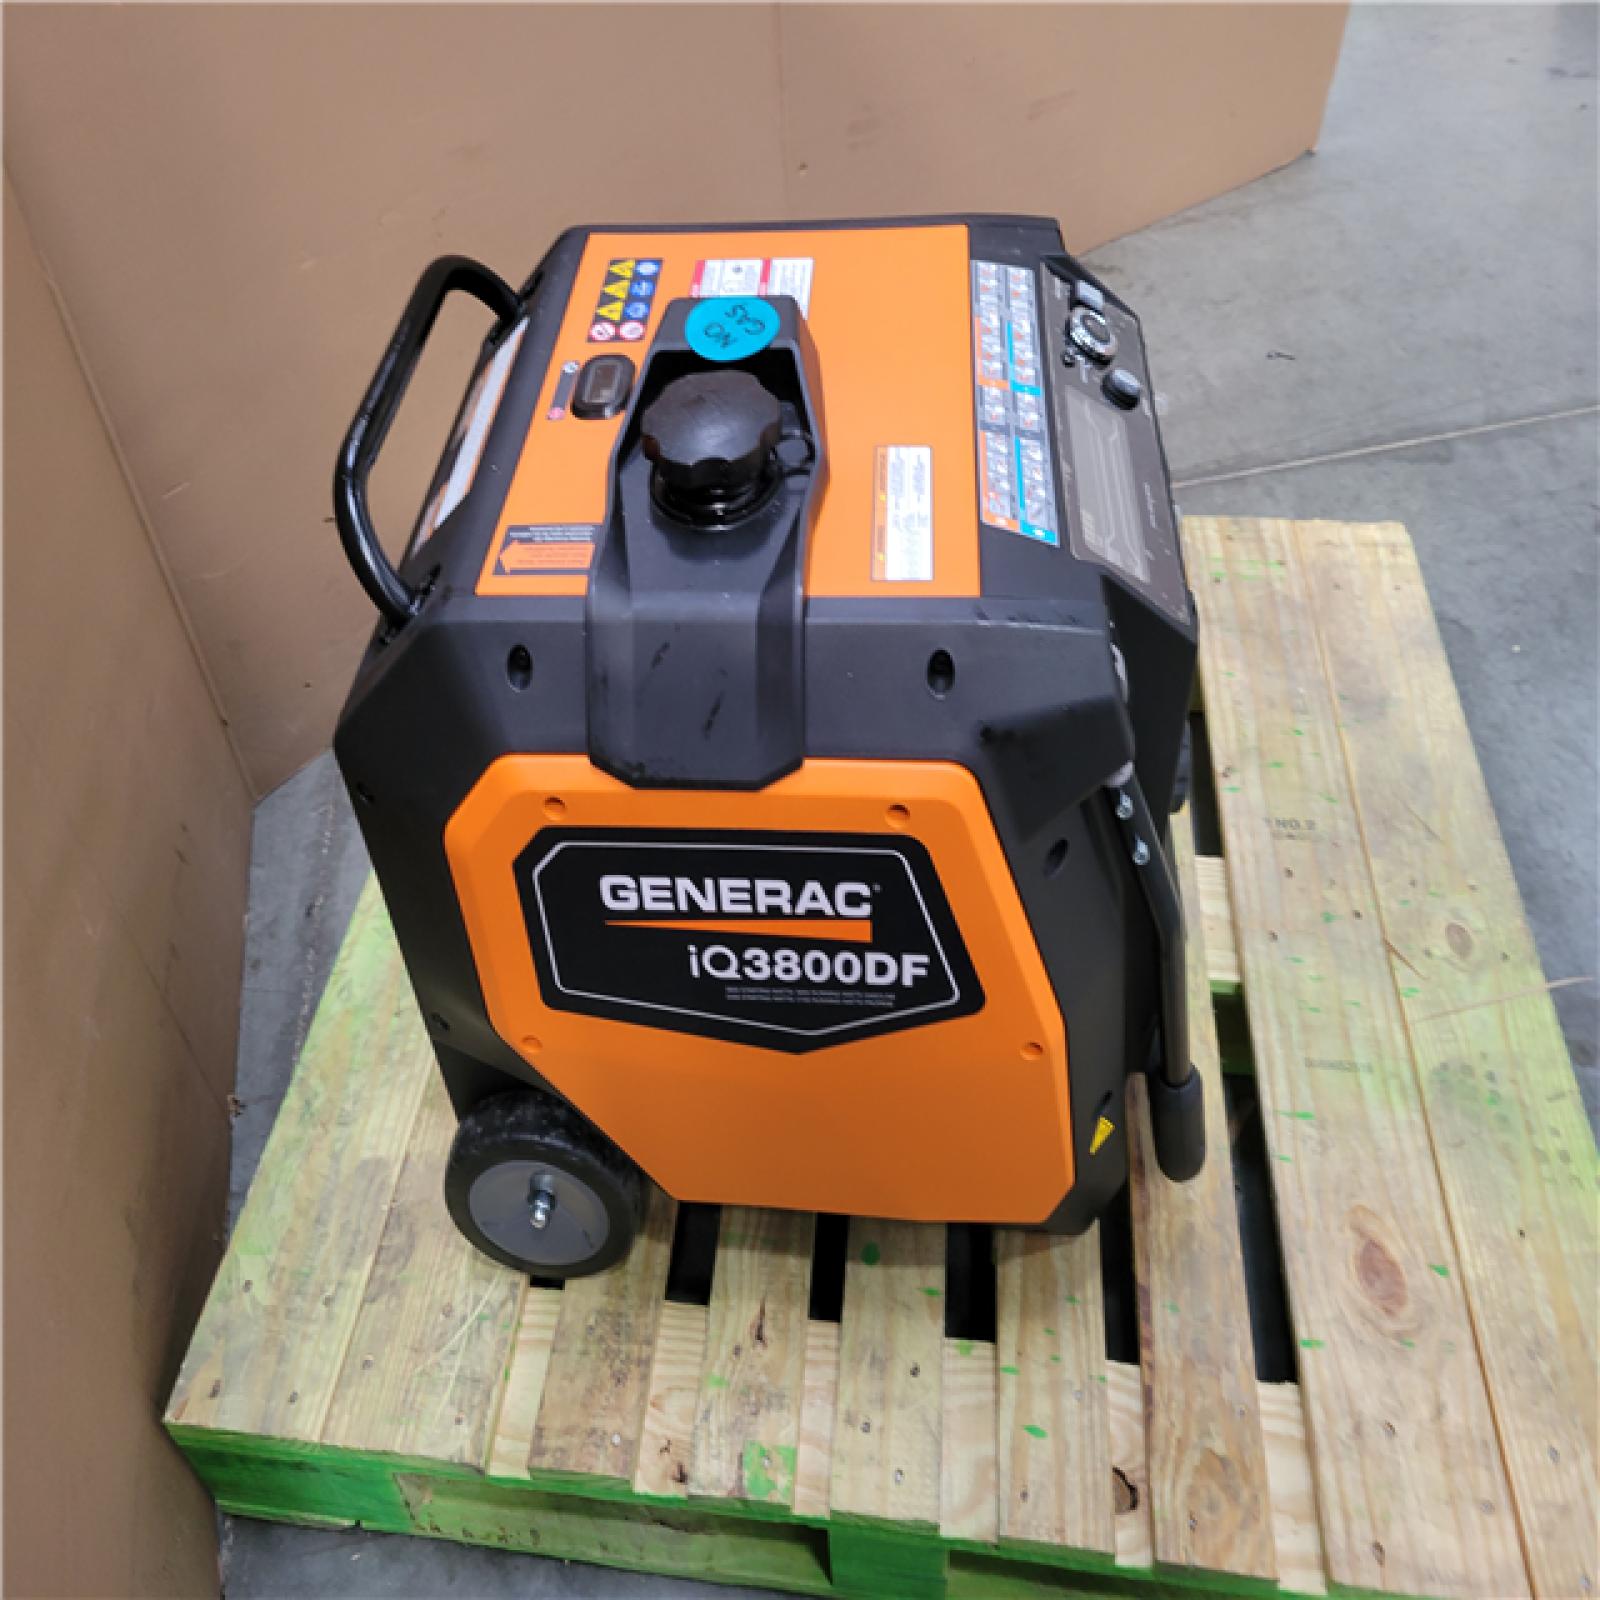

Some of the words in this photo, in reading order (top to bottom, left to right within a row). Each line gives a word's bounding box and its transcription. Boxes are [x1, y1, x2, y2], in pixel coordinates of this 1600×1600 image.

[703, 321, 738, 349] NO
[725, 303, 766, 336] GAS
[599, 874, 872, 918] GENERAC
[688, 944, 930, 987] iQ3800DF
